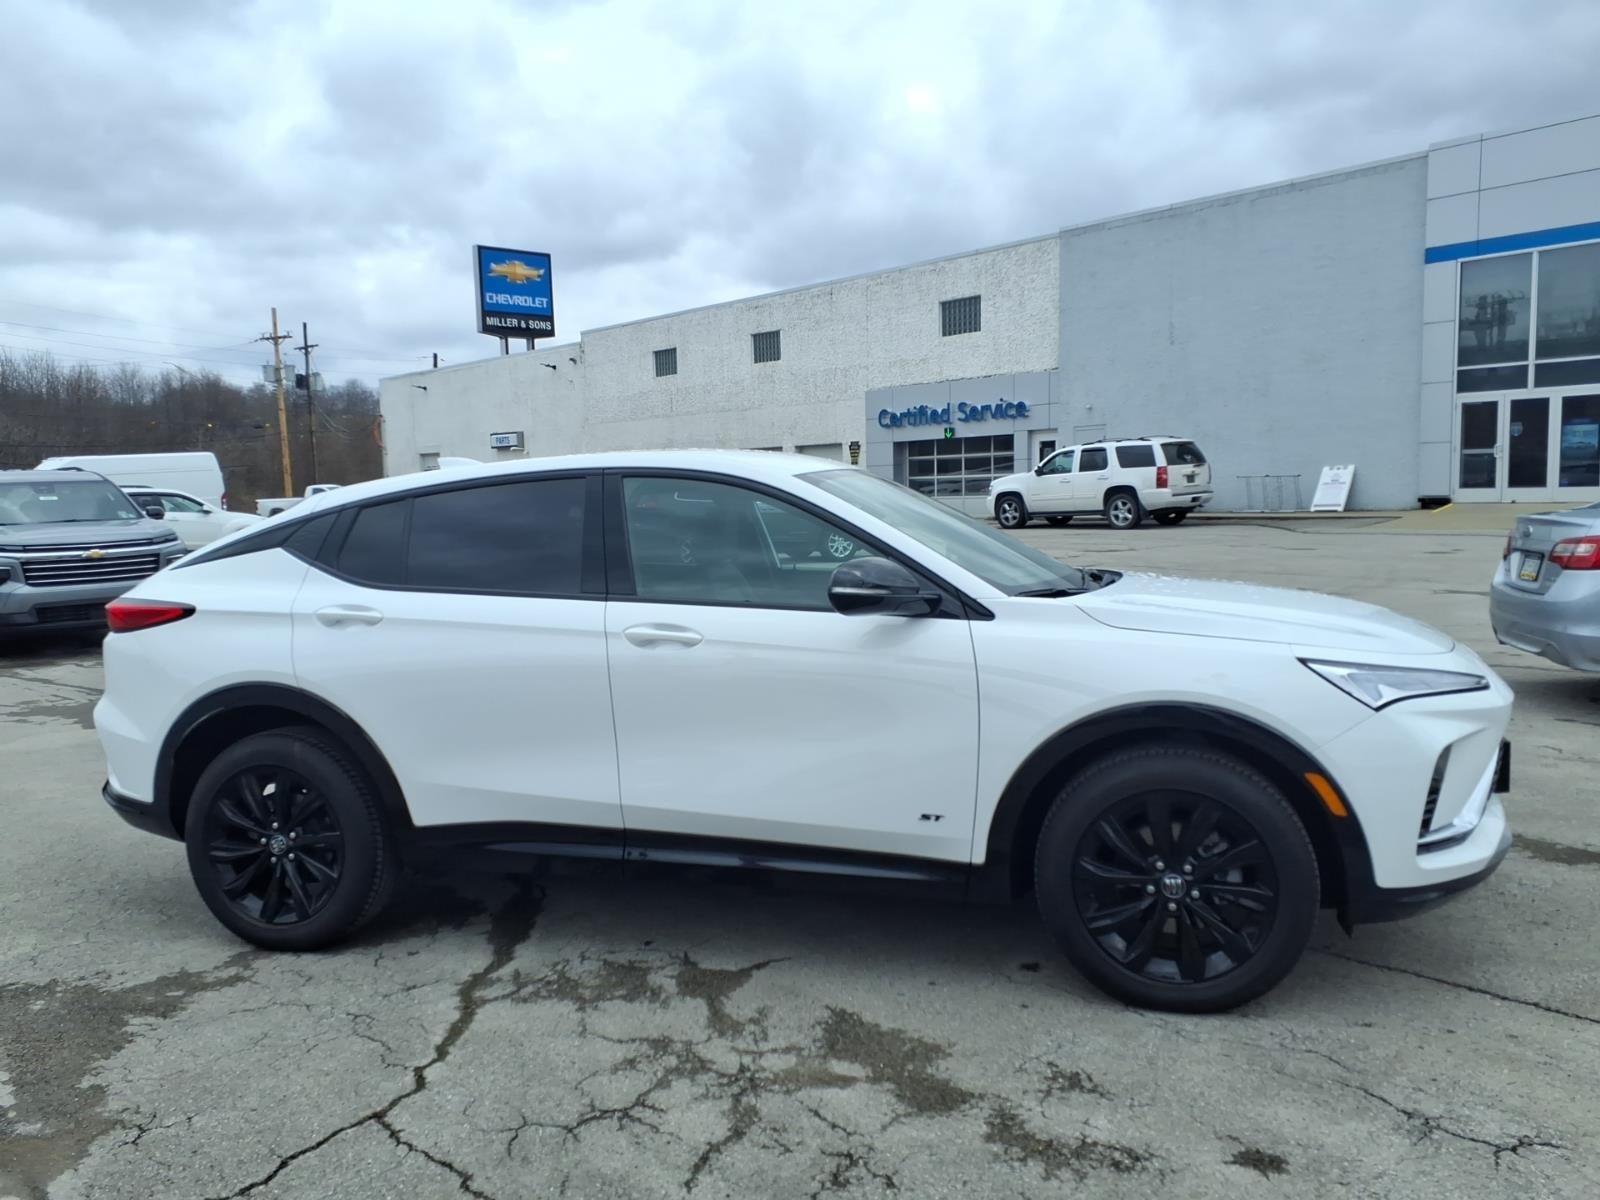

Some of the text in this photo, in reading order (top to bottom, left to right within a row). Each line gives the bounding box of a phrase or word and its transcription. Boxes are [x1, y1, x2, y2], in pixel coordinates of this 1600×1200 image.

[486, 293, 548, 308] CHEVROLET
[486, 317, 552, 330] MILLER & SONS
[878, 398, 1030, 428] Certified Service
[918, 813, 945, 822] ST
